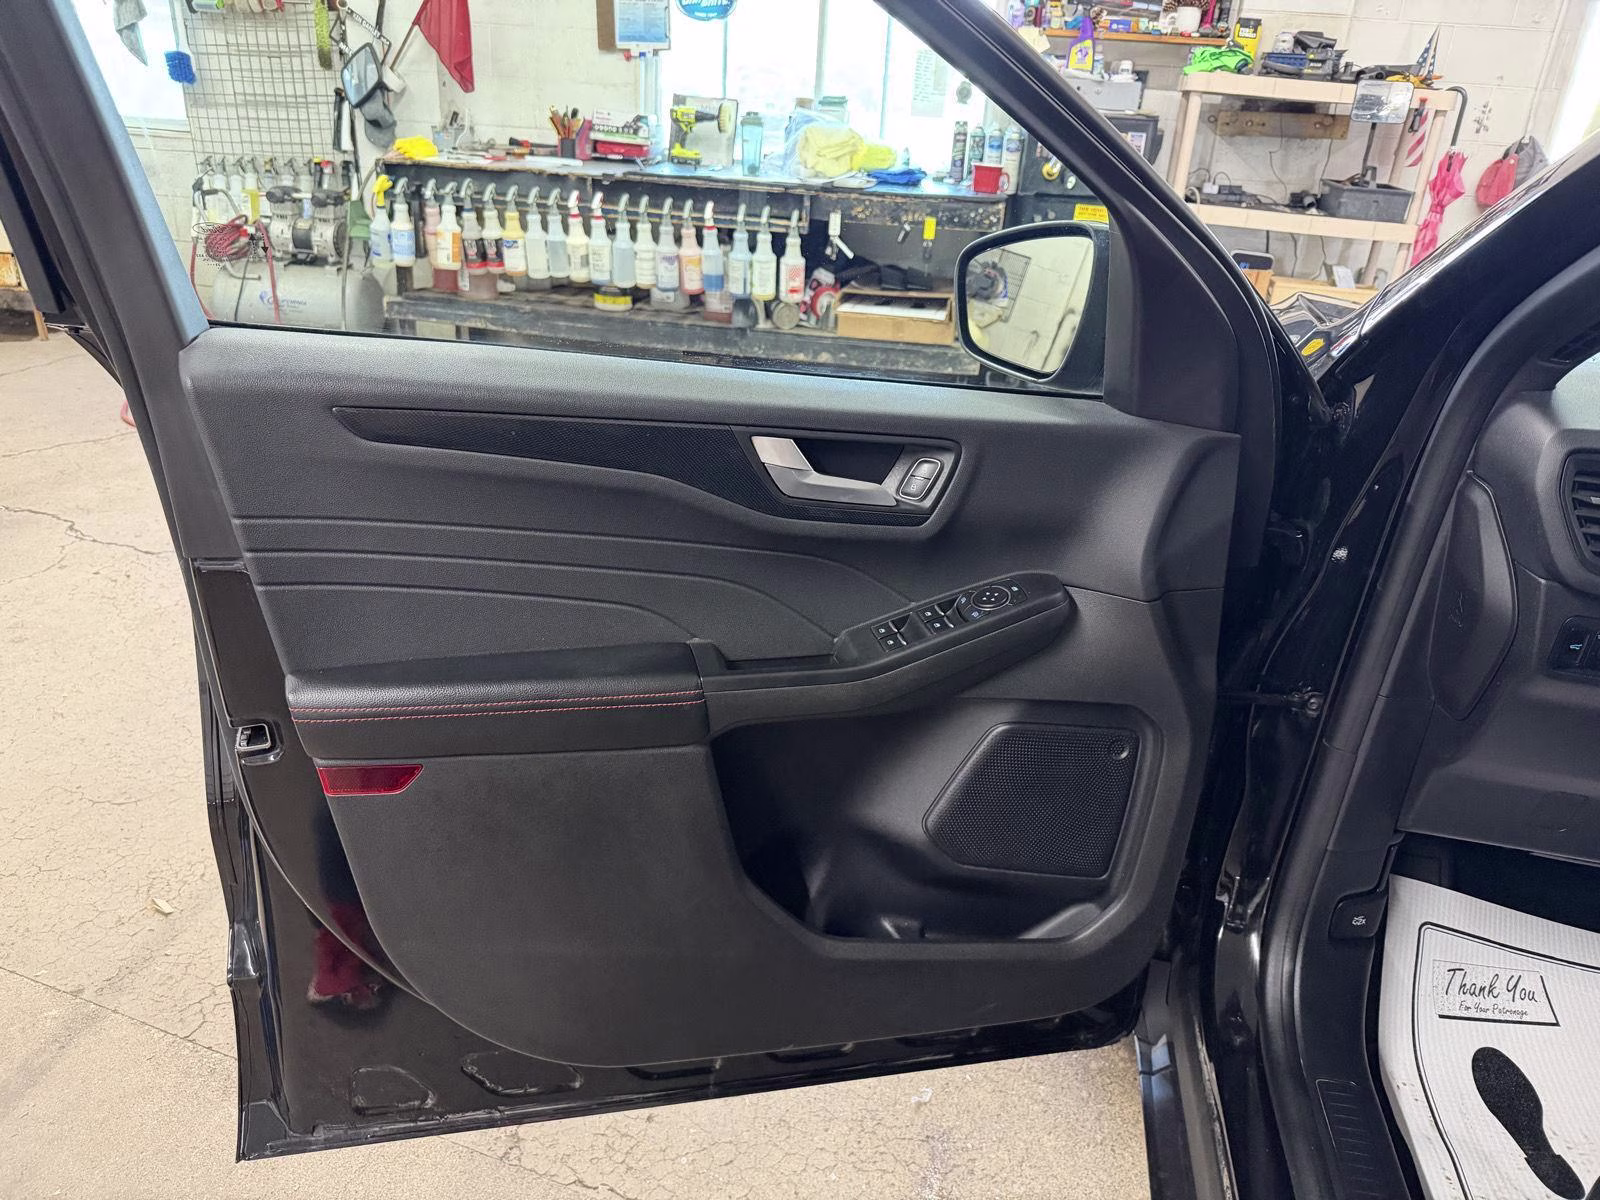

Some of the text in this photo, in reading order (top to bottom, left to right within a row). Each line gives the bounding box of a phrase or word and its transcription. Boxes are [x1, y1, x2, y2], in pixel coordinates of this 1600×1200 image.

[1445, 968, 1538, 1002] Thank You
[1459, 1000, 1528, 1019] For Your Patronage
